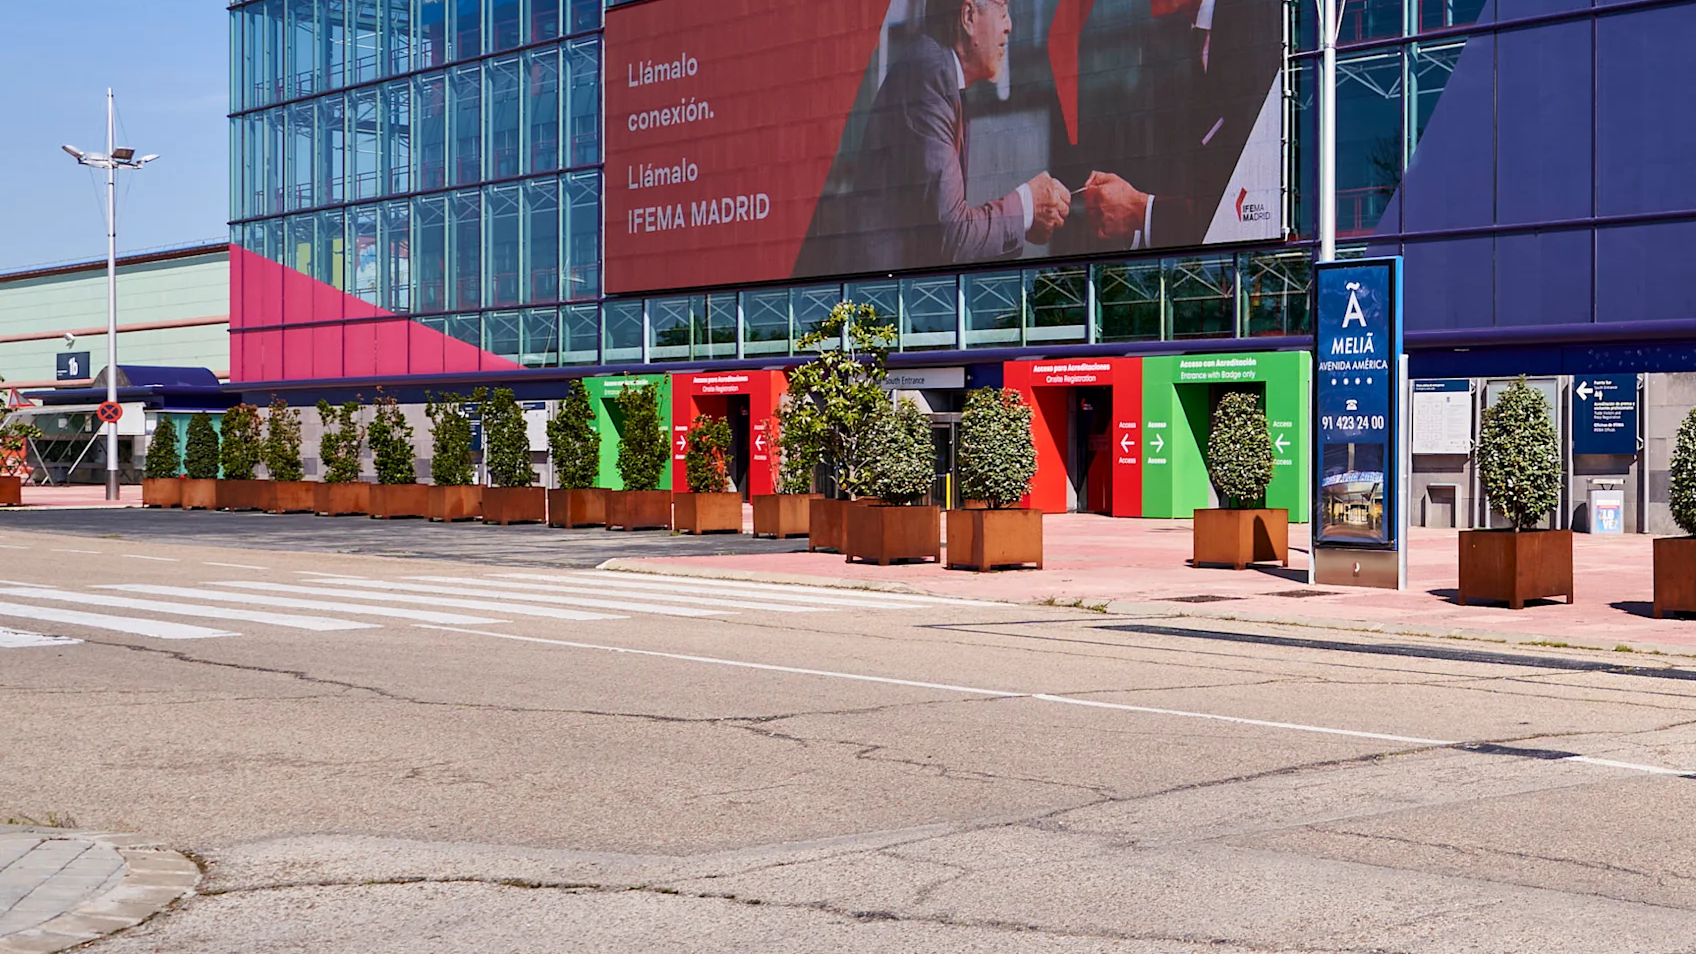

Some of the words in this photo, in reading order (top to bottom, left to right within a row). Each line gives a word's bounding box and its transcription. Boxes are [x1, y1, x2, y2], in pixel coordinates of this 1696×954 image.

[628, 52, 698, 87] Llámalo
[628, 97, 714, 131] conexión.
[628, 157, 698, 189] Llámalo
[628, 204, 685, 234] IFEMA
[691, 193, 770, 227] MADRID
[1242, 204, 1265, 213] IFEMA
[1242, 211, 1270, 221] MADRID
[1033, 365, 1053, 373] Acceso
[1067, 363, 1111, 371] Acreditaciones
[1180, 360, 1203, 368] Acceso
[1215, 358, 1257, 367] Acreditación
[1319, 361, 1351, 371] AVENIDA
[1352, 358, 1388, 370] AMÉRICA
[1046, 375, 1063, 383] Onsite
[1063, 375, 1096, 384] Registration
[1181, 372, 1207, 380] Entrance
[1221, 371, 1241, 380] Badge
[1242, 370, 1256, 379] only
[885, 376, 900, 385] South
[901, 376, 925, 385] Entrance
[1322, 416, 1333, 430] 91
[1336, 416, 1355, 430] 423
[1356, 416, 1369, 430] 24
[1371, 415, 1384, 430] 00
